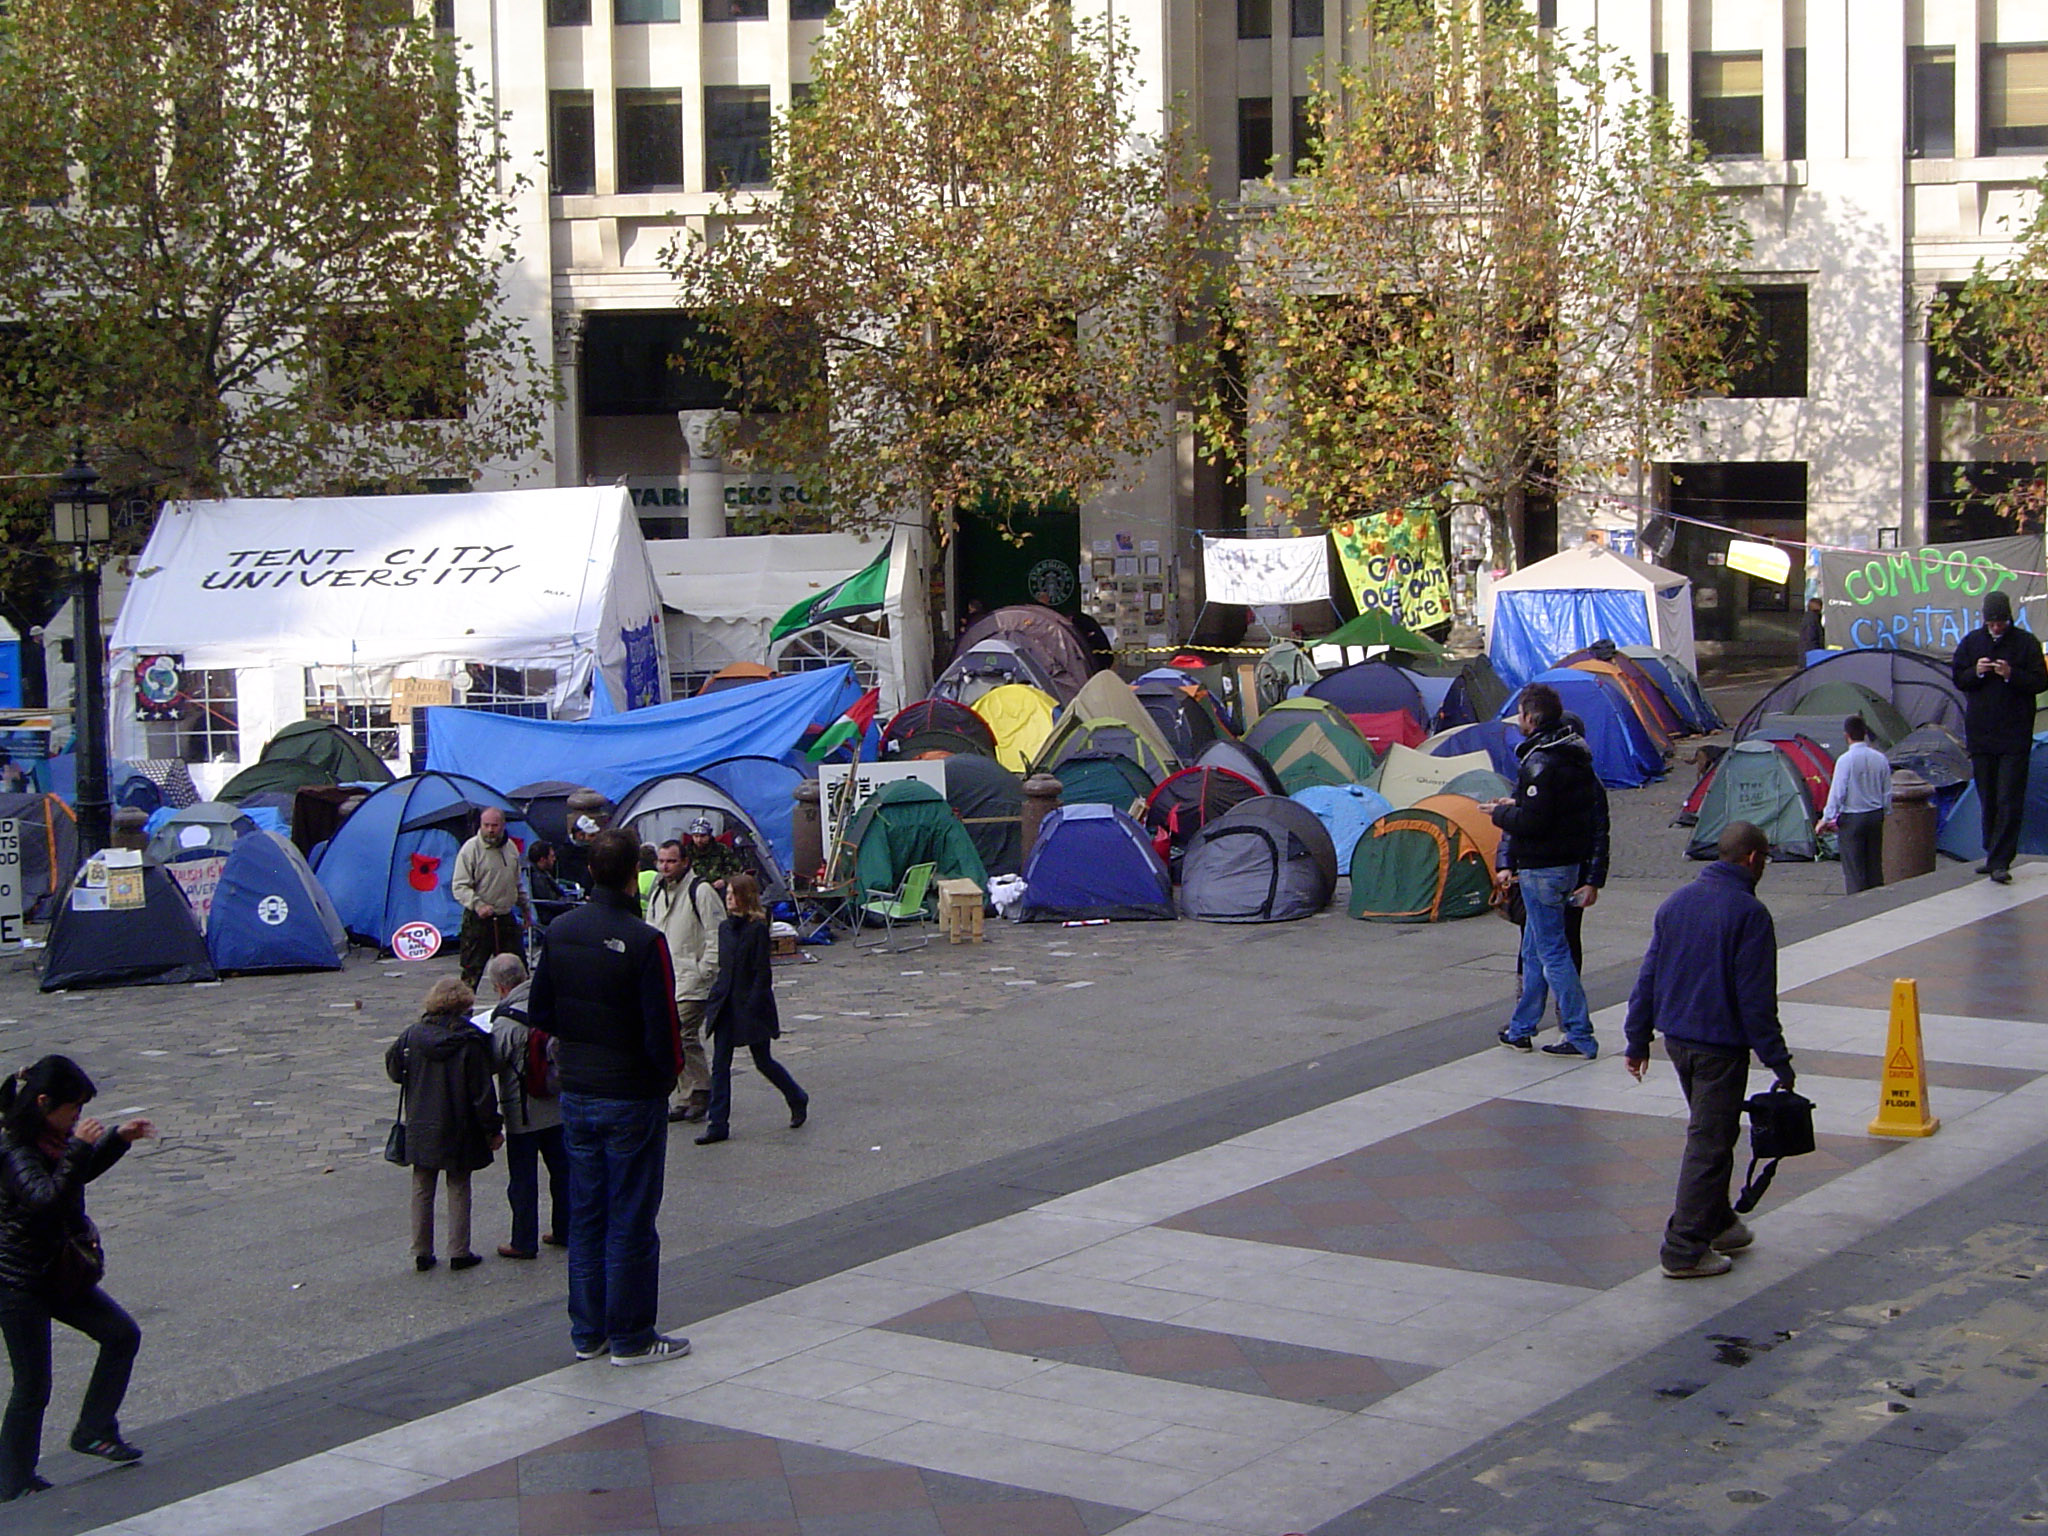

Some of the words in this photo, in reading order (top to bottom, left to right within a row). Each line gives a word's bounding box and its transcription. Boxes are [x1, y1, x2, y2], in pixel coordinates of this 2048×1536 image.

[630, 485, 772, 507] TARCKS
[229, 548, 355, 567] TENT
[384, 545, 514, 565] CITY
[201, 565, 521, 589] UNIVERSITY
[1845, 548, 2018, 605] COMPOST
[859, 776, 871, 799] THE
[1, 914, 21, 943] E
[398, 927, 432, 938] STOP
[1885, 1100, 1916, 1108] FLOOR
